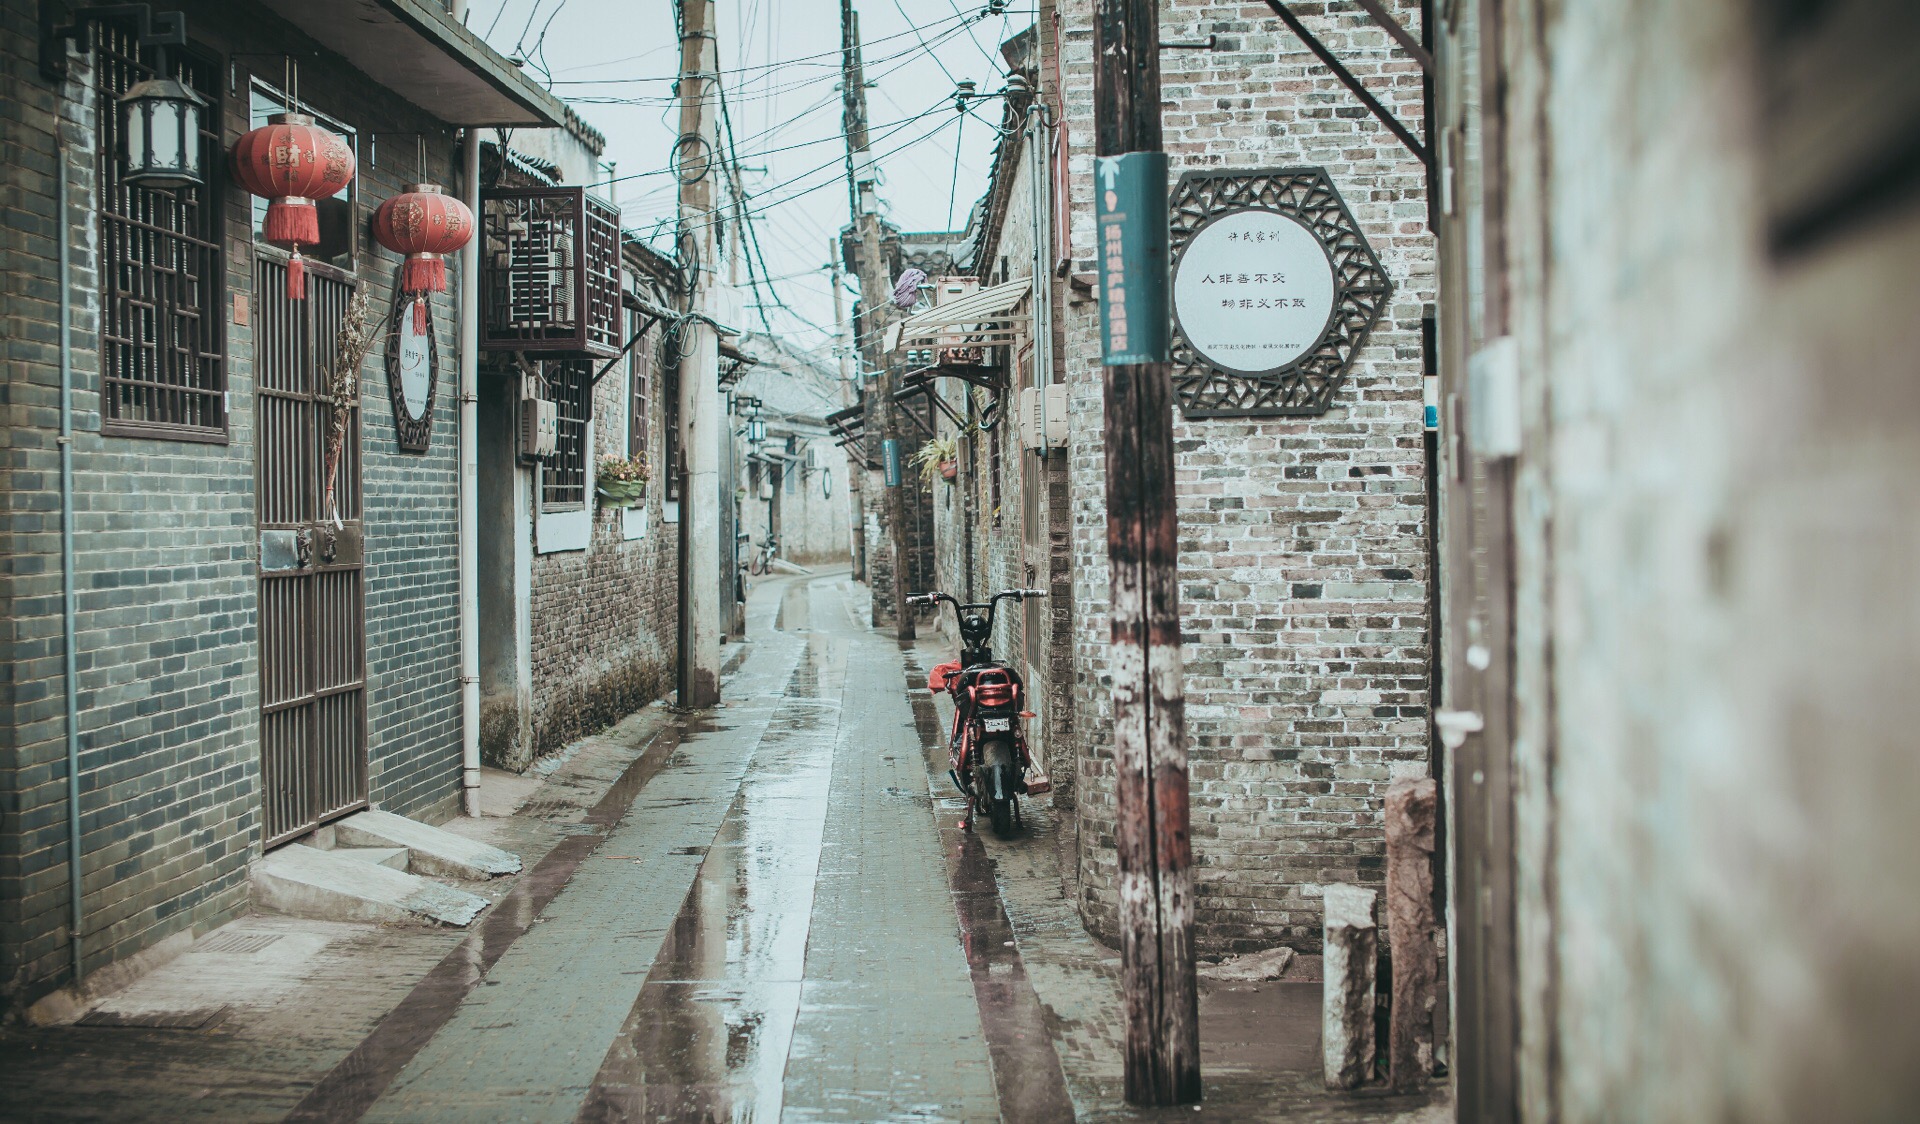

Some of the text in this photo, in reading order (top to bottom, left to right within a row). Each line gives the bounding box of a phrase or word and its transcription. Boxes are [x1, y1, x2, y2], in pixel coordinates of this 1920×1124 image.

[1227, 231, 1280, 243] 许氏家训
[1202, 272, 1286, 284] 人非善不交
[1221, 298, 1306, 310] 物非义不取
